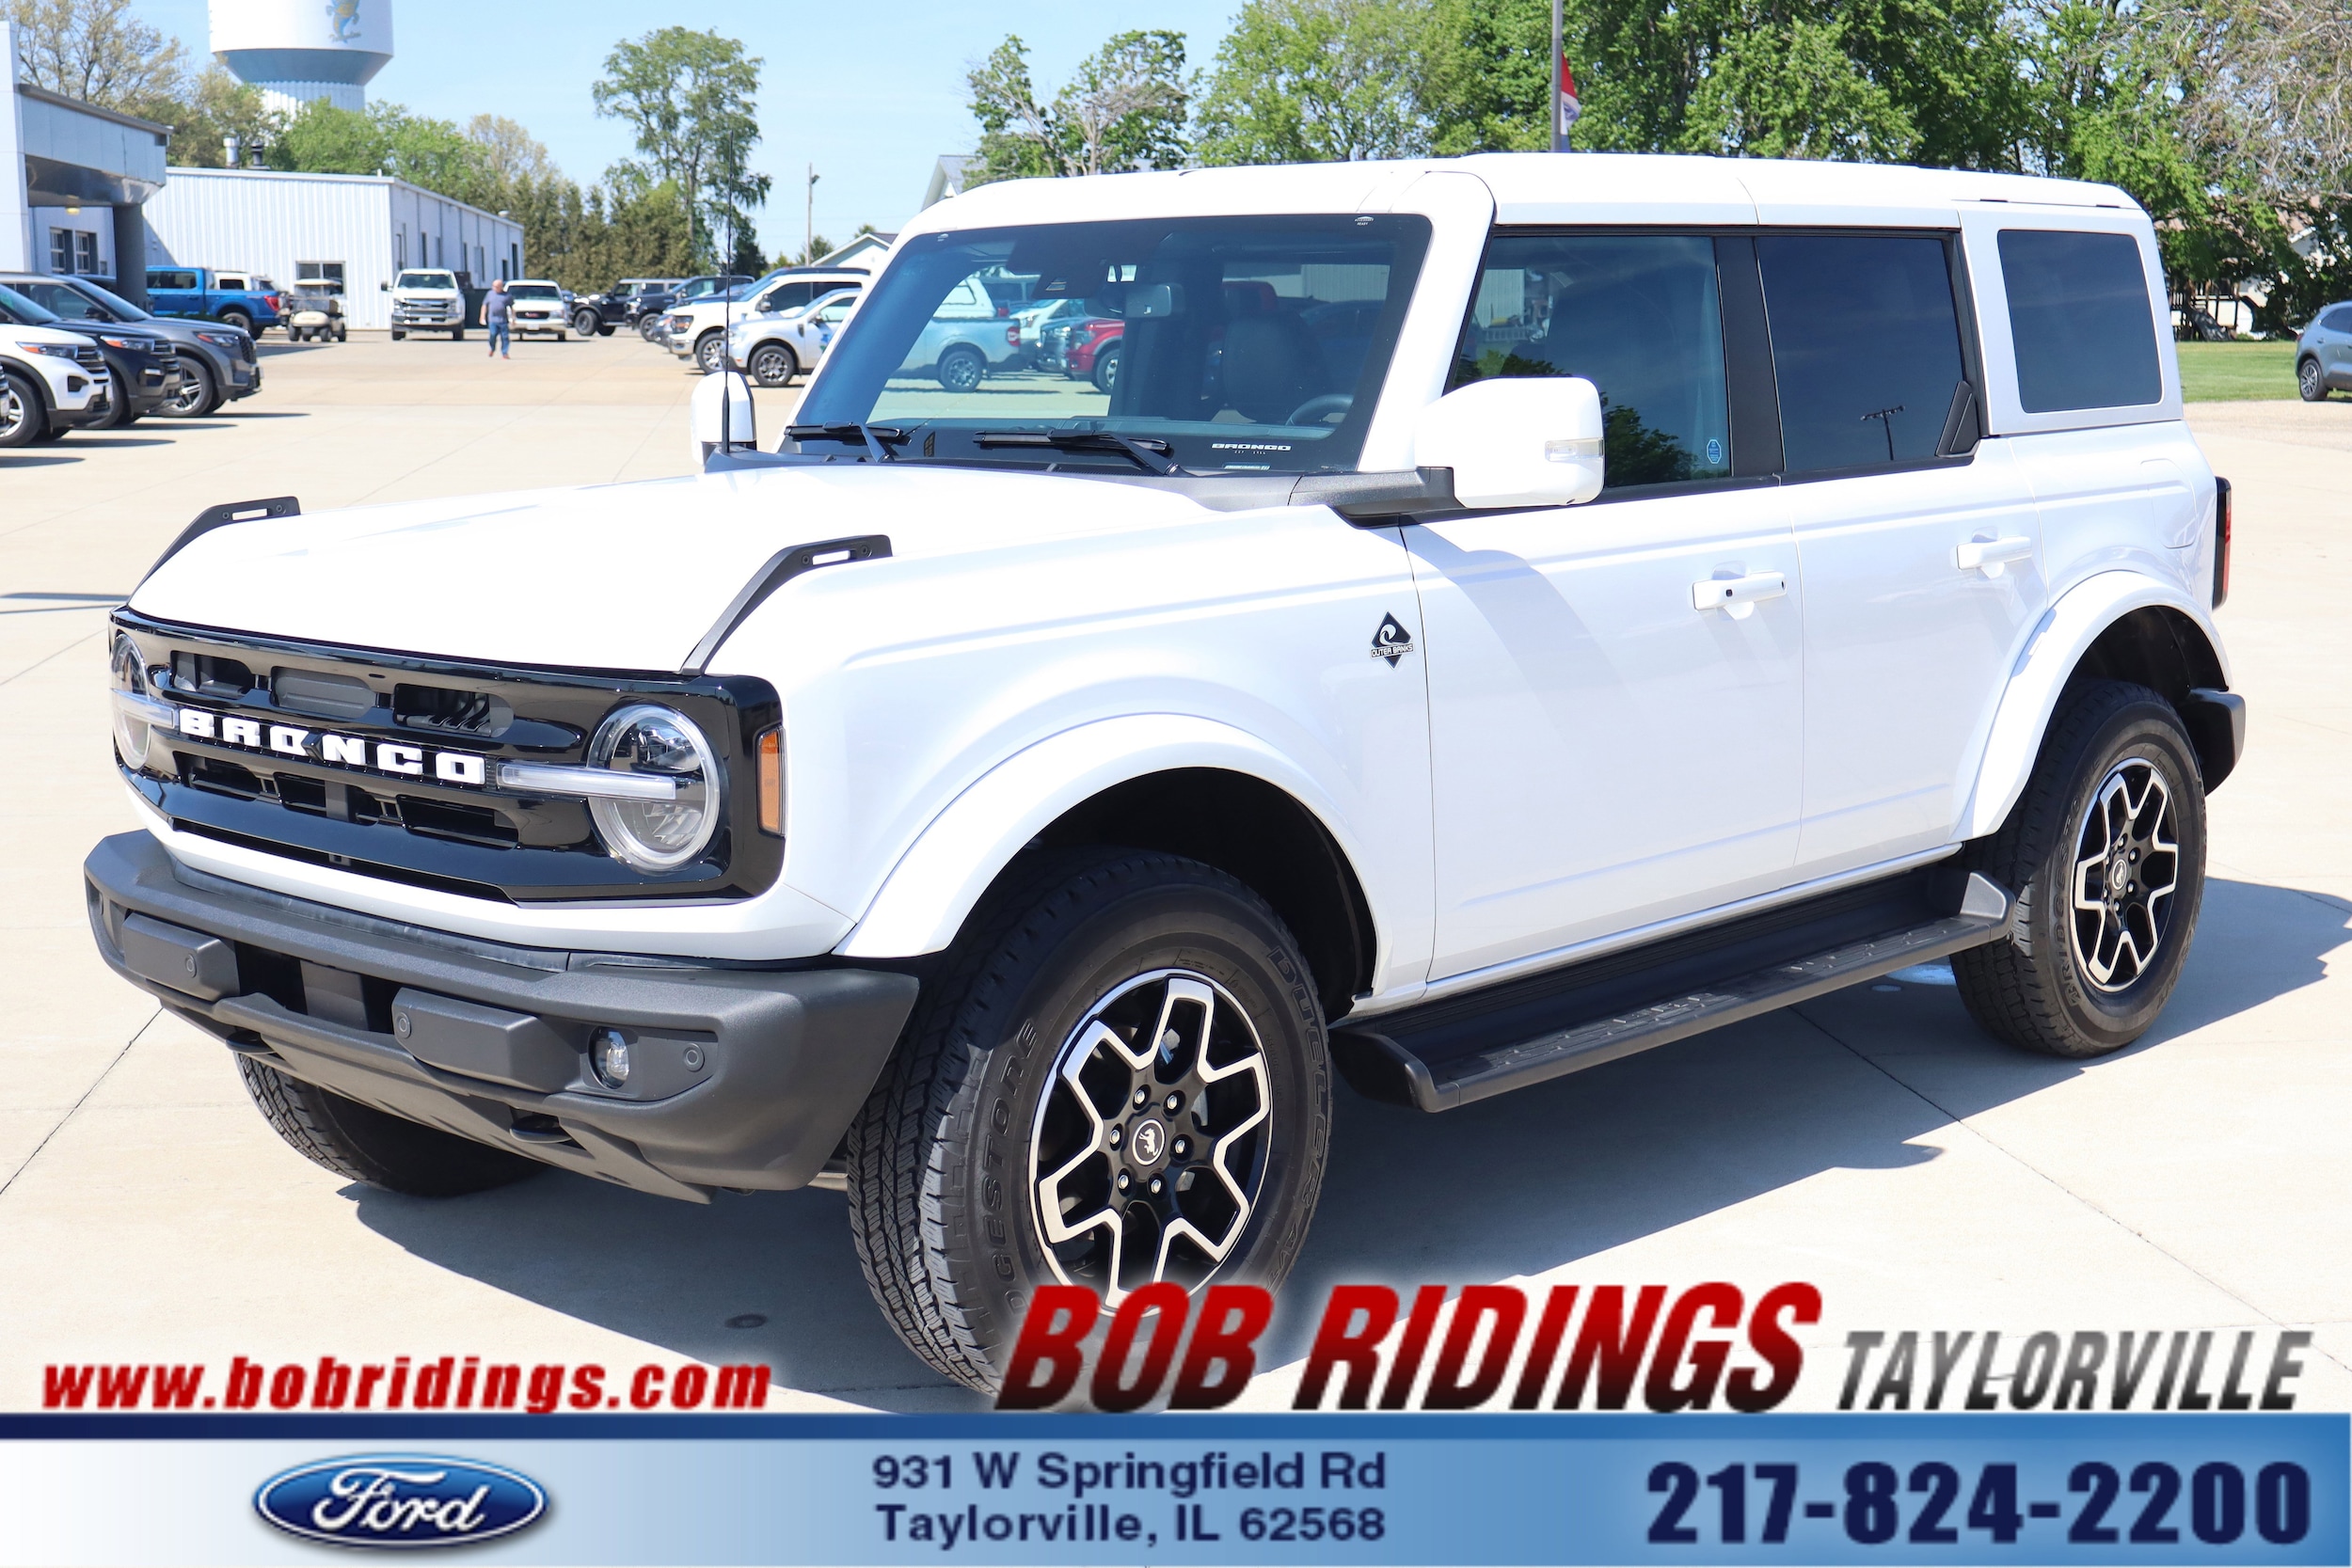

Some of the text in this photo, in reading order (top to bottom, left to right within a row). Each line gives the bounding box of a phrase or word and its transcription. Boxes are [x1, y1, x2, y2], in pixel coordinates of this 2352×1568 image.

[1212, 443, 1292, 451] BRONCO
[1372, 644, 1413, 657] OUTER BANKS
[180, 708, 485, 785] BRONCO
[1266, 945, 1327, 1212] DUELER
[981, 1018, 1037, 1315] DGESTONE
